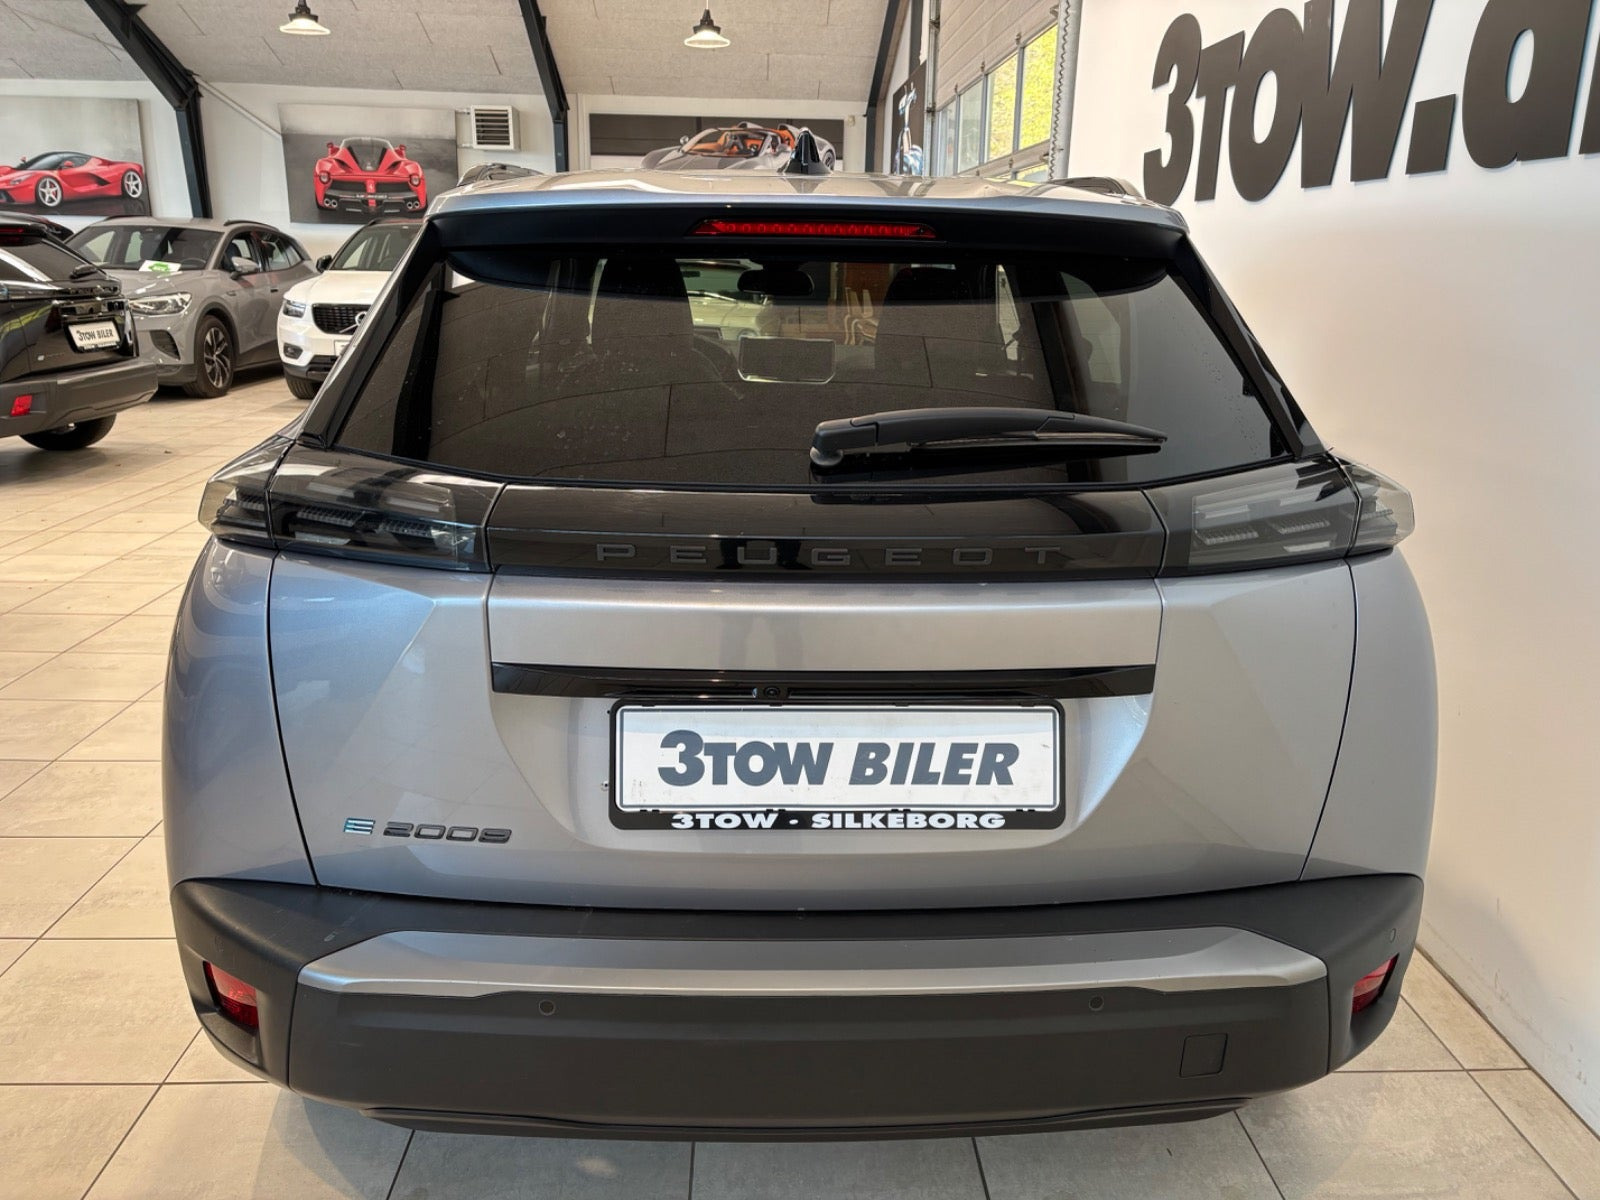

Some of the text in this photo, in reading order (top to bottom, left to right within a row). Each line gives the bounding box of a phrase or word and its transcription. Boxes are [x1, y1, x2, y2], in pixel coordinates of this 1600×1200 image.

[1143, 0, 1600, 206] 3TOW.d
[596, 543, 1061, 566] PEUGEOT
[658, 729, 1020, 787] 3TOW BILER
[671, 812, 779, 829] 3TOW
[811, 812, 1006, 829] SILKEBORG
